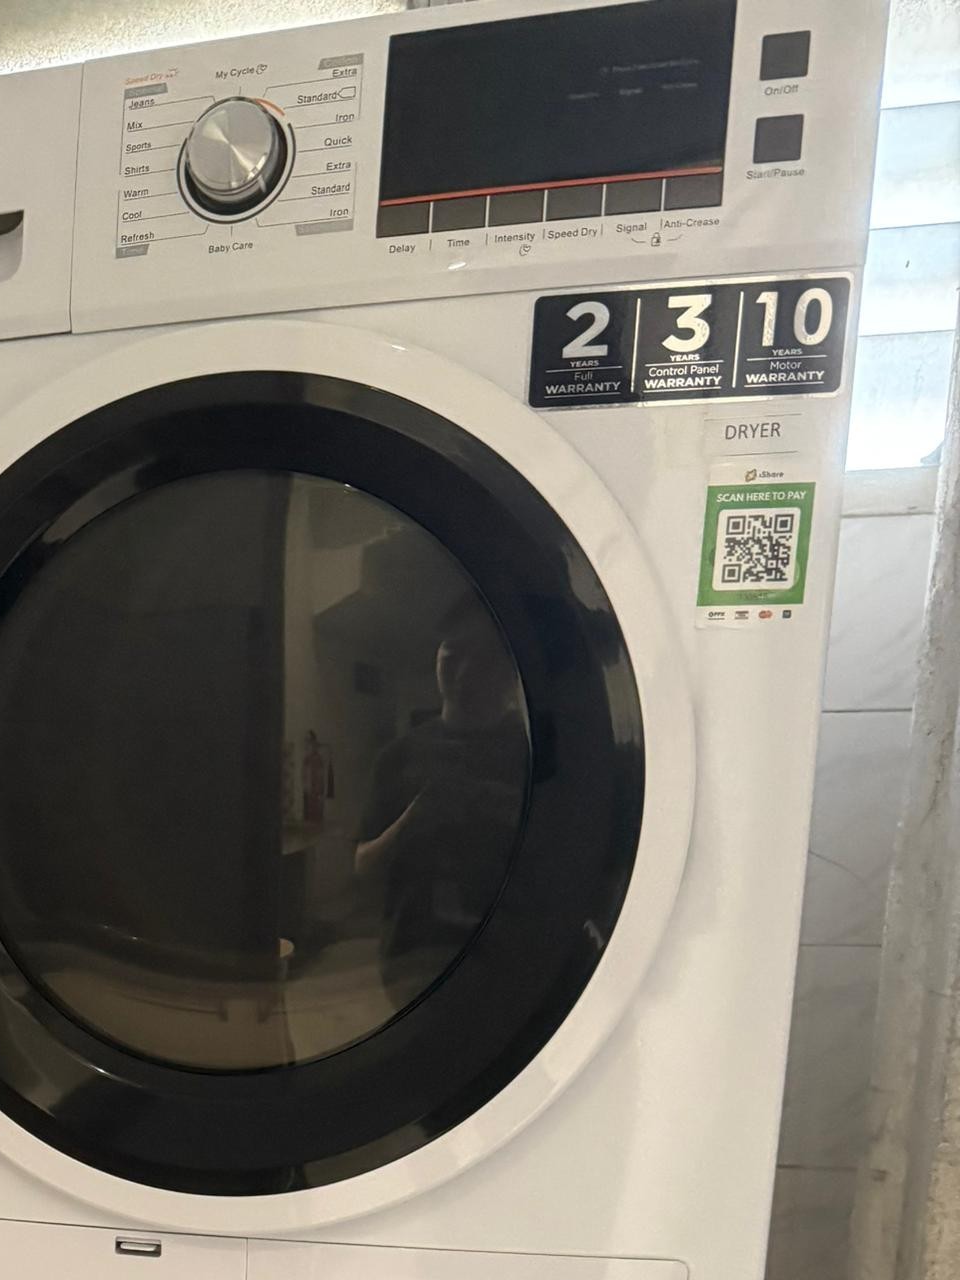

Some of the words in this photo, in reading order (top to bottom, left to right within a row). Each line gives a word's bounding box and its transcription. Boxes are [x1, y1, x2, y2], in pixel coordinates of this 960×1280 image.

[215, 70, 228, 79] My
[230, 66, 255, 78] Cycle
[332, 68, 357, 78] Extra
[764, 84, 799, 96] On/Off
[297, 91, 337, 104] Standard
[129, 99, 155, 109] Jeans
[336, 113, 355, 122] Iron
[127, 121, 143, 130] Mix
[126, 142, 152, 152] Sports
[324, 136, 352, 147] Quick
[124, 165, 150, 175] Shirts
[326, 161, 351, 171] Extra
[746, 167, 805, 180] Start/Pause
[123, 189, 149, 198] Warm
[311, 182, 350, 195] Standard
[122, 211, 142, 220] Cool
[330, 208, 349, 216] Iron
[616, 222, 647, 234] Signal
[664, 217, 720, 229] Anti-Crease
[120, 232, 155, 243] Refresh
[495, 232, 535, 243] Intensity
[548, 229, 578, 239] Speed
[581, 227, 598, 238] Dry
[208, 243, 229, 254] Baby
[230, 241, 253, 250] Care
[447, 238, 470, 247] Time
[389, 243, 416, 254] Delay
[755, 287, 834, 347] 10
[661, 294, 713, 353] 3
[562, 301, 611, 359] 2
[670, 353, 700, 362] YEARS
[772, 348, 802, 356] YEARS
[648, 365, 688, 377] Control
[690, 363, 719, 375] Panel
[770, 360, 802, 370] Motor
[574, 371, 593, 381] Full
[745, 370, 825, 383] WARRANTY
[545, 381, 622, 394] WARRANTY
[644, 376, 722, 389] WARRANTY
[725, 423, 781, 440] DRYER
[716, 492, 744, 502] SCAN
[746, 491, 771, 501] HERE
[772, 491, 785, 500] TO
[787, 490, 807, 500] PAY
